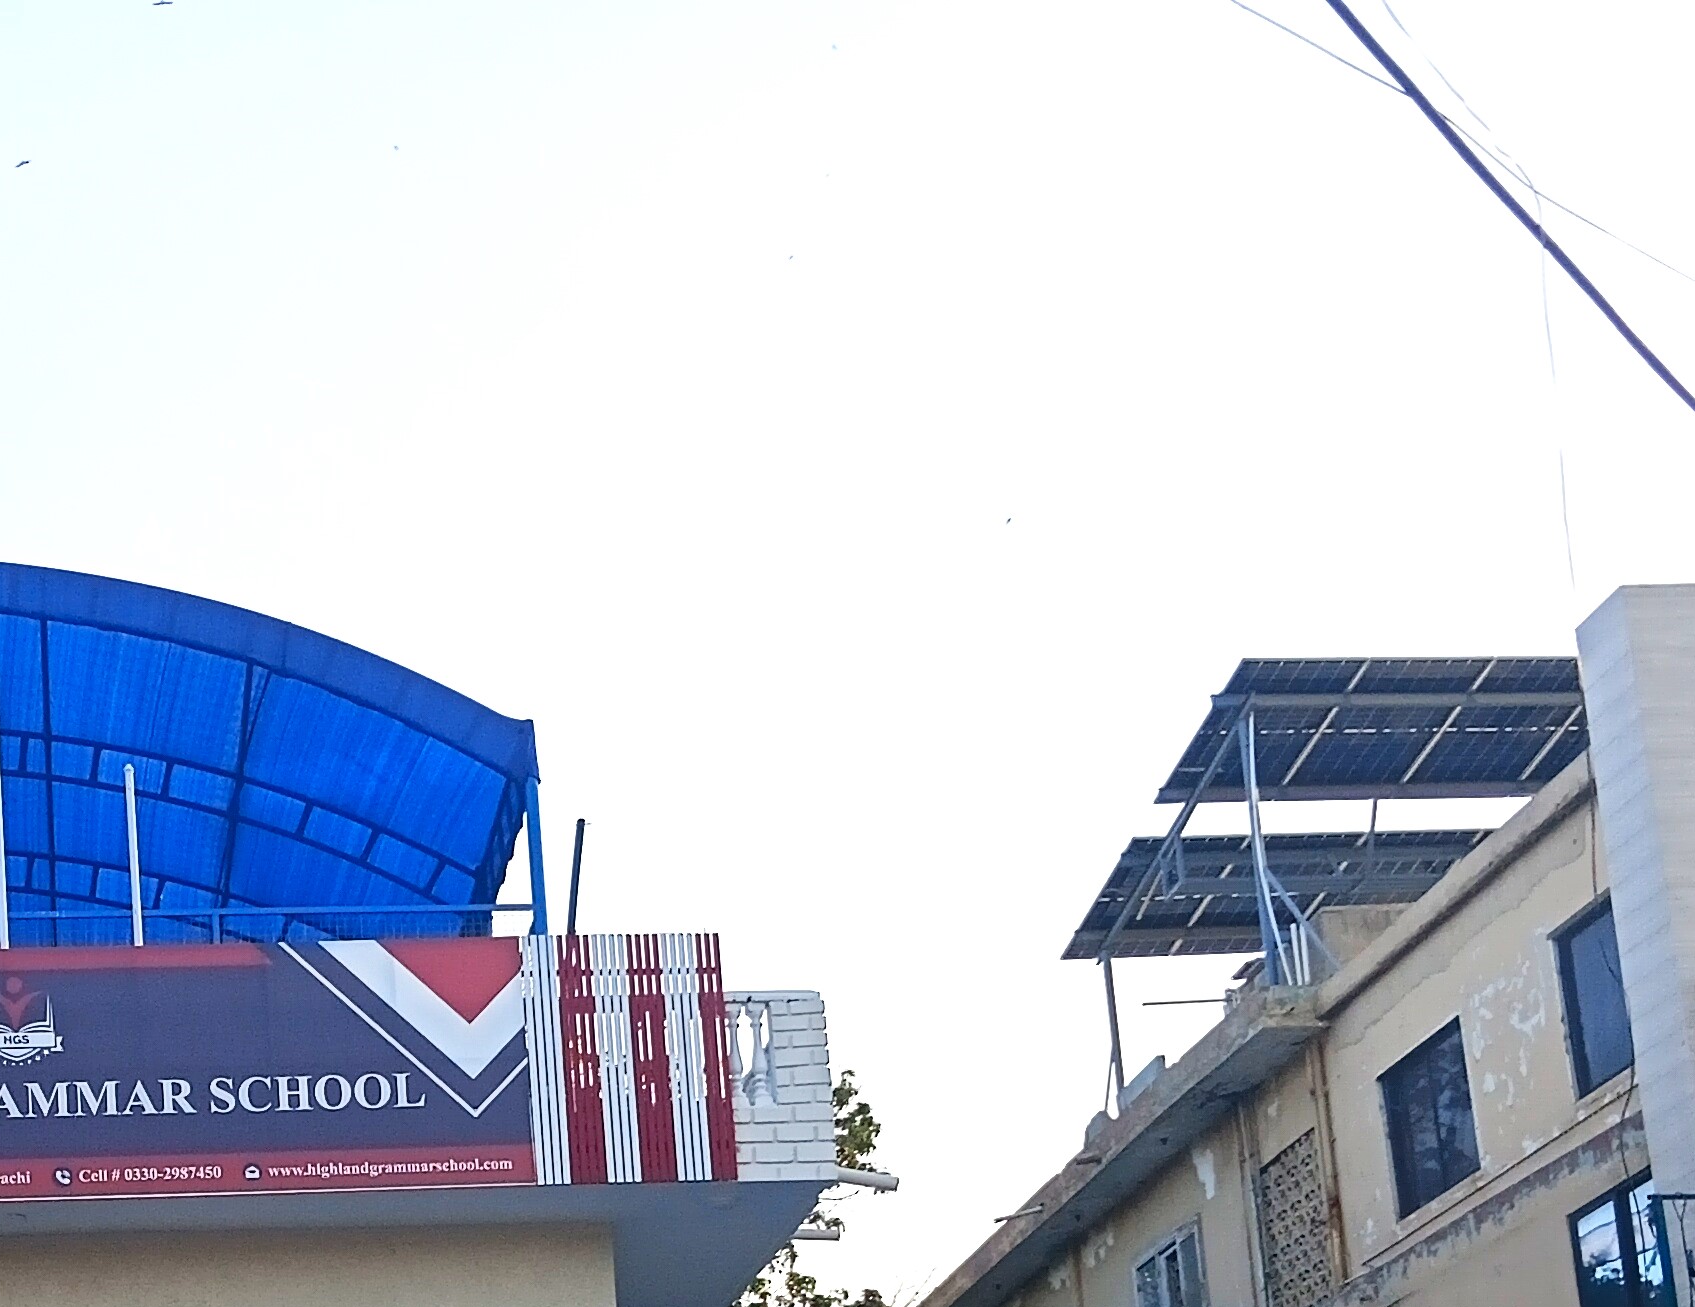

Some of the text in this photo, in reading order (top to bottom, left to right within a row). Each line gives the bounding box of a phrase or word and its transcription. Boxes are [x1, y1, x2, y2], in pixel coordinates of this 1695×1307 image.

[3, 1034, 30, 1045] HGS
[210, 1071, 427, 1115] SCHOOL
[78, 1165, 222, 1183] Cell # 0330-2987450
[267, 1158, 514, 1178] www.highlandgrammarschool.com
